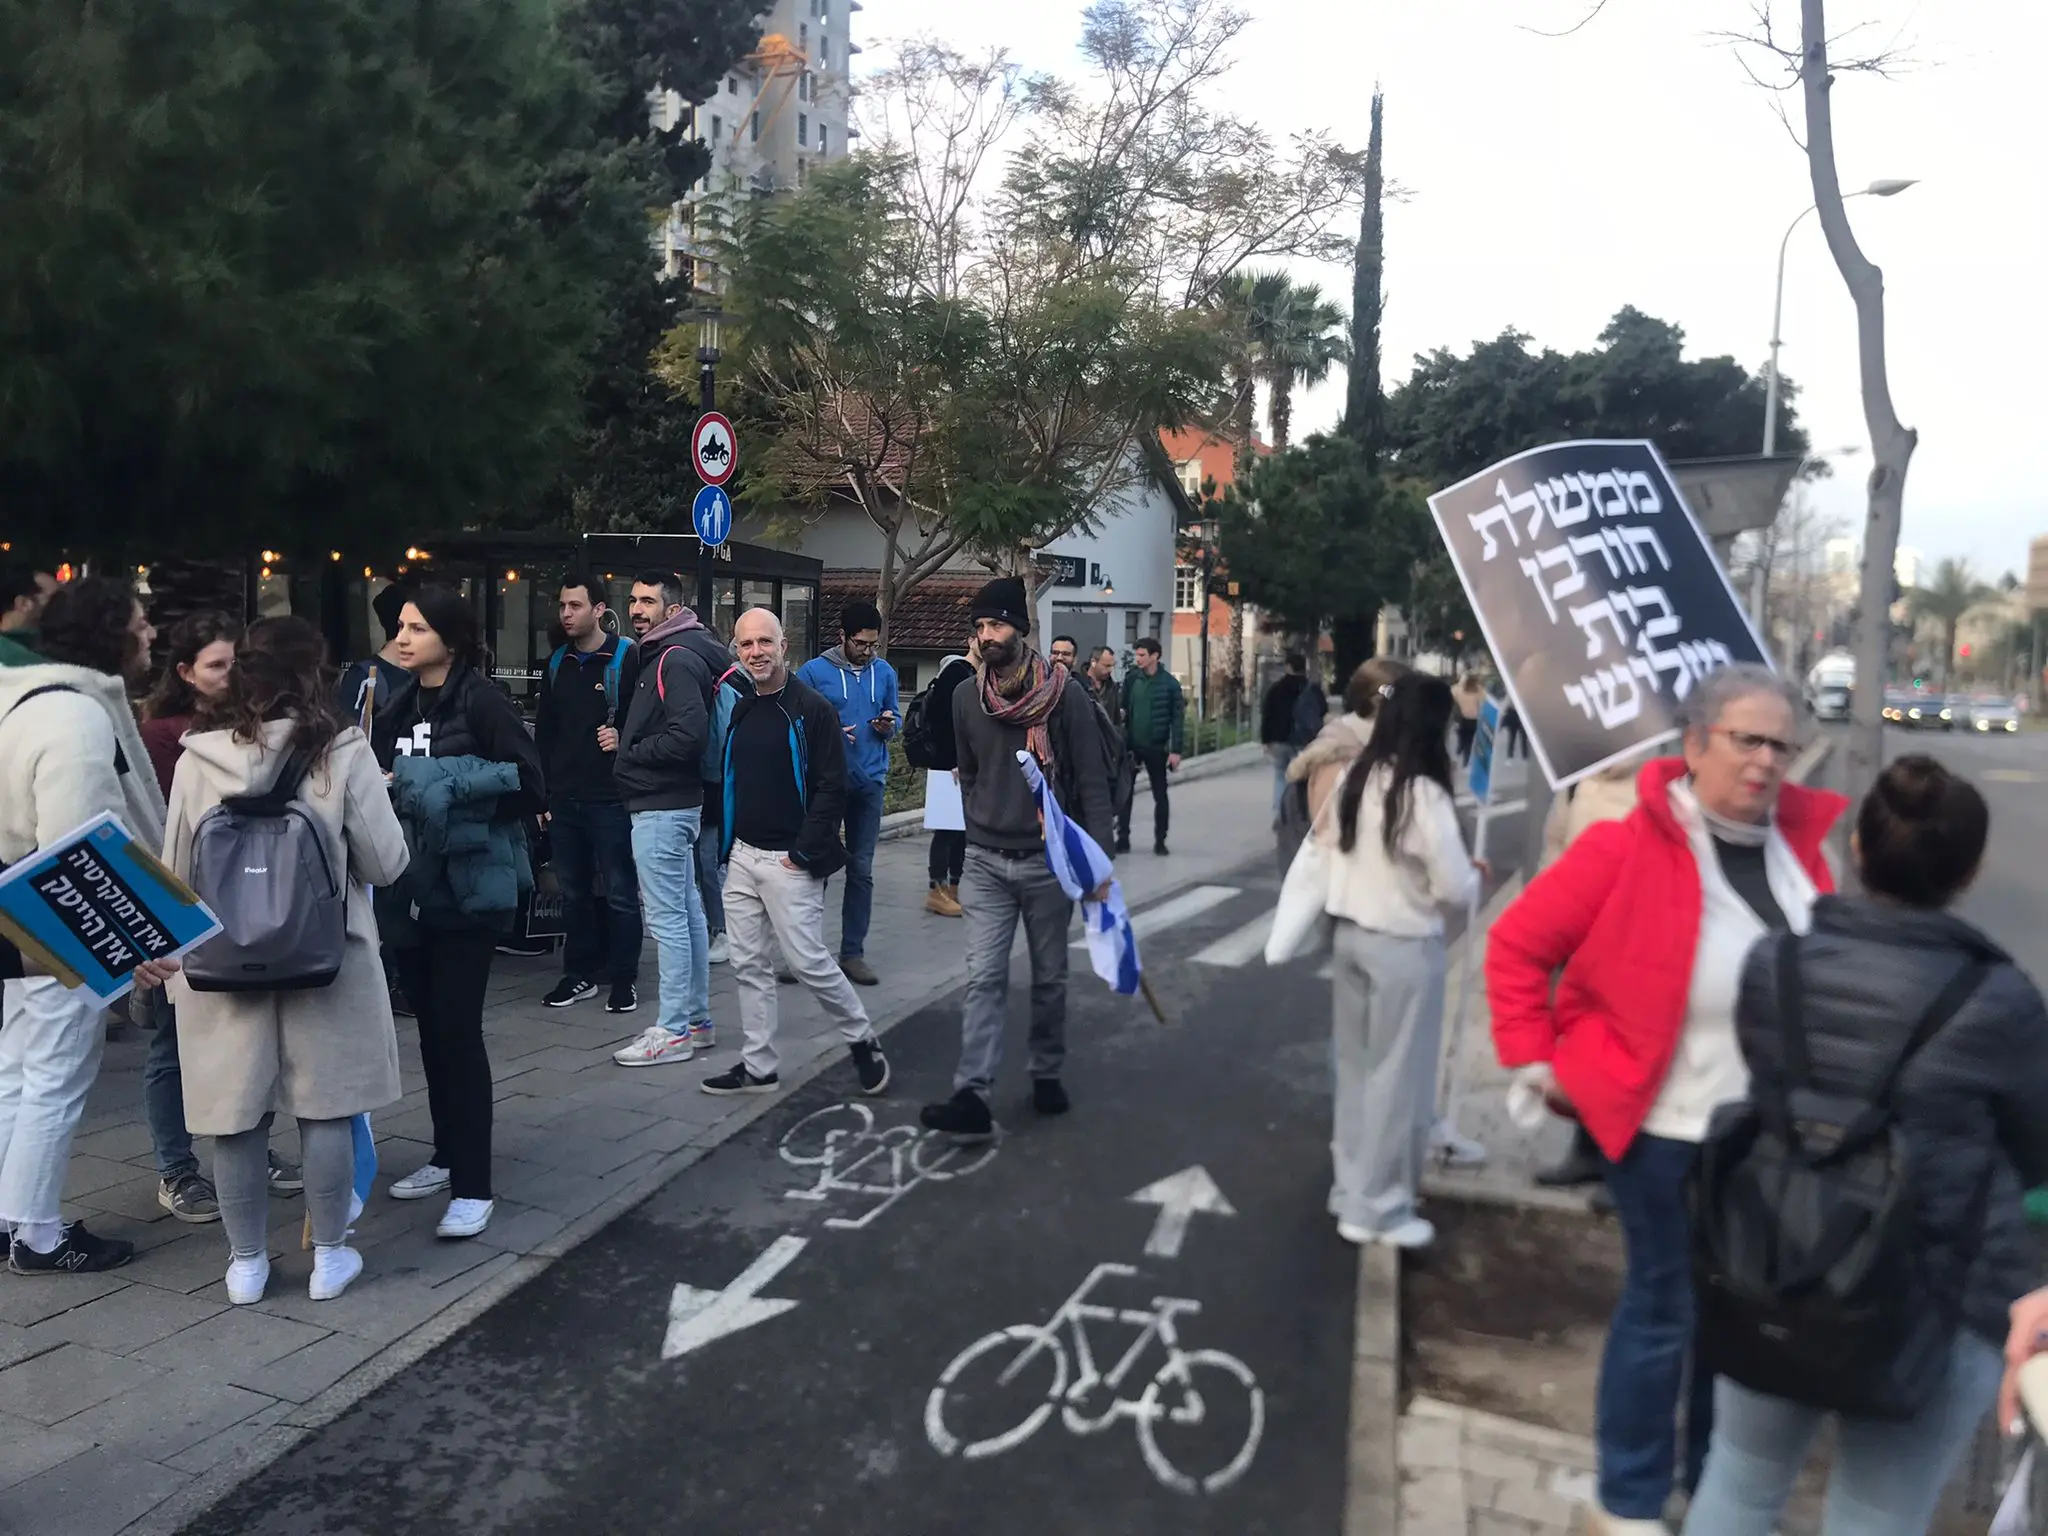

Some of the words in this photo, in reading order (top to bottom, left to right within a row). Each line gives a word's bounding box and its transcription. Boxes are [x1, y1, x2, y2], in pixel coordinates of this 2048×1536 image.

[1467, 467, 1664, 562] ממשלת
[1518, 524, 1673, 625] חורבן
[1568, 585, 1682, 660] בית
[40, 875, 106, 937] הייטק
[68, 849, 146, 927] דמוקרטיה
[92, 931, 134, 966] אין
[133, 922, 168, 951] אין
